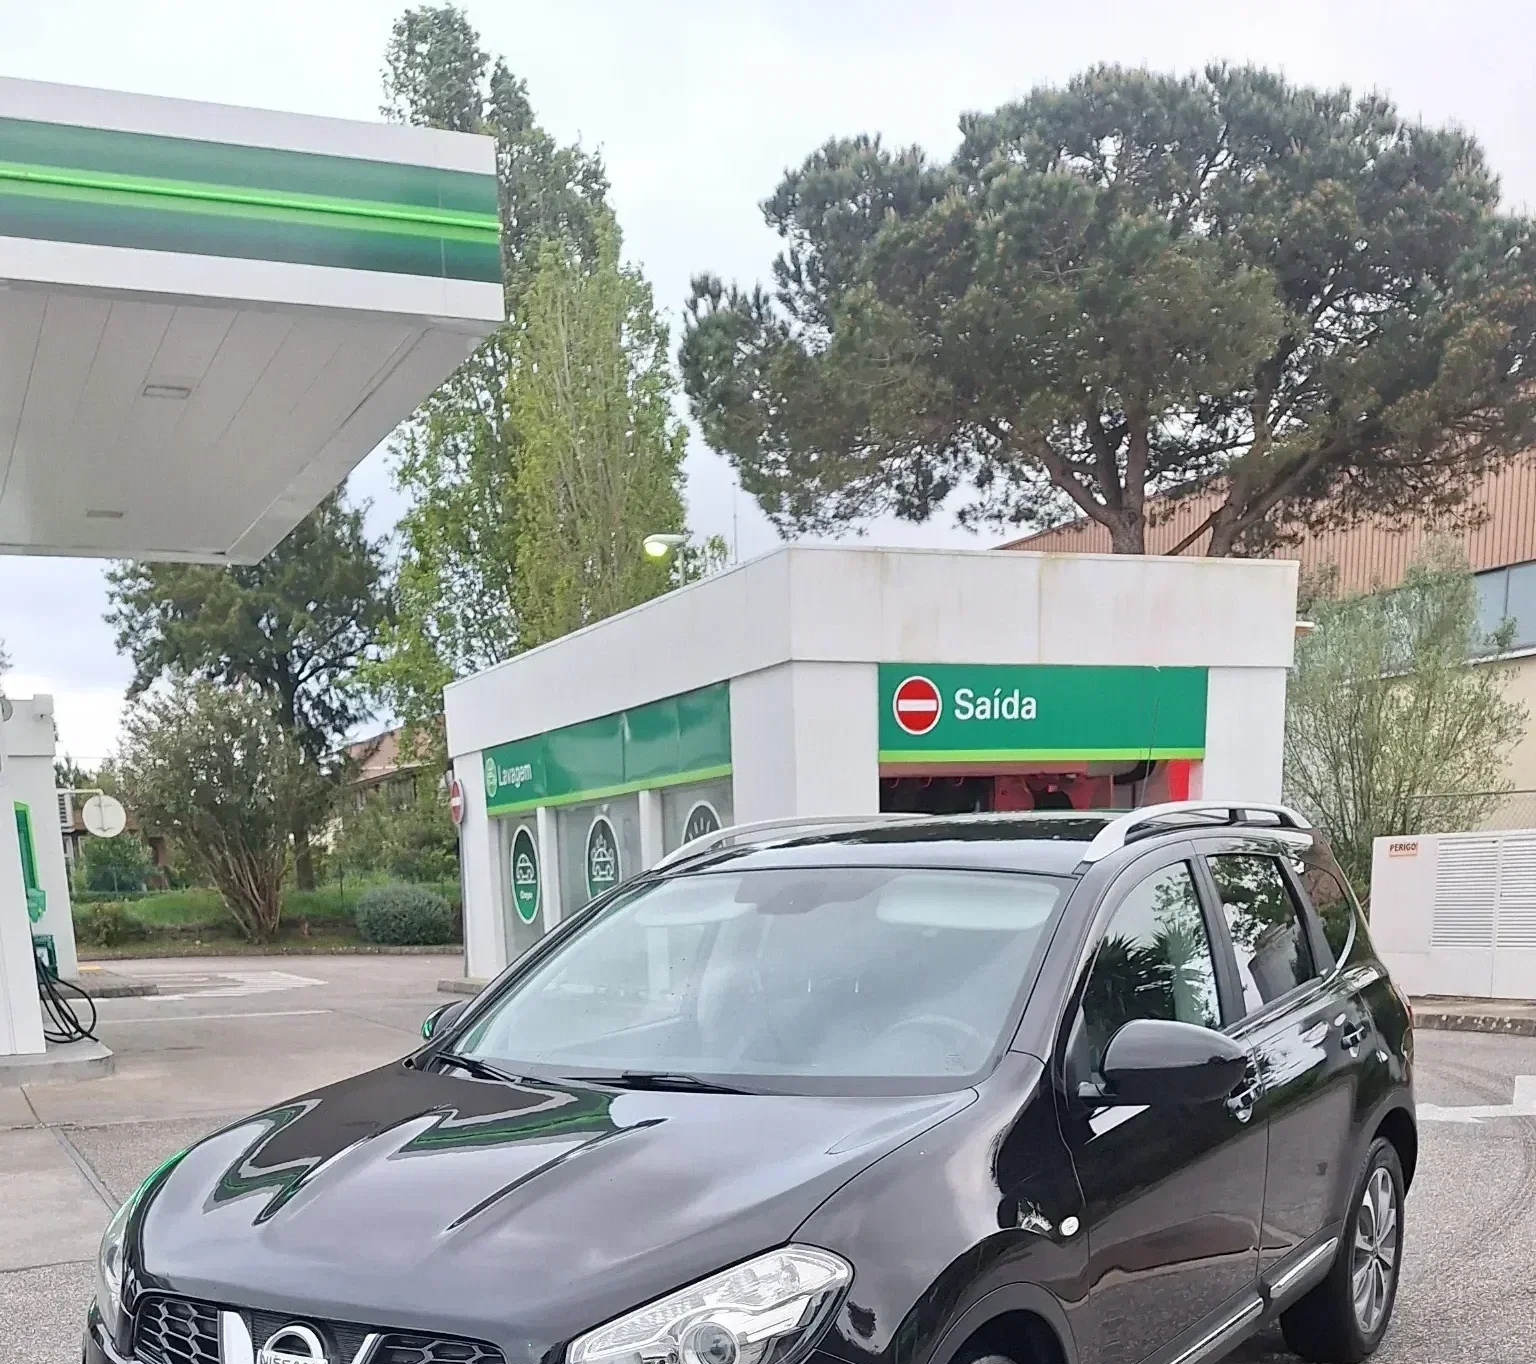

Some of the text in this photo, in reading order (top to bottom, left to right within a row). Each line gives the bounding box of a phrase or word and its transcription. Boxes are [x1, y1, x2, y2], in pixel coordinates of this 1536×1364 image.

[954, 687, 1036, 720] Saída
[497, 763, 533, 788] Lavagem
[1389, 843, 1416, 852] PERIGO
